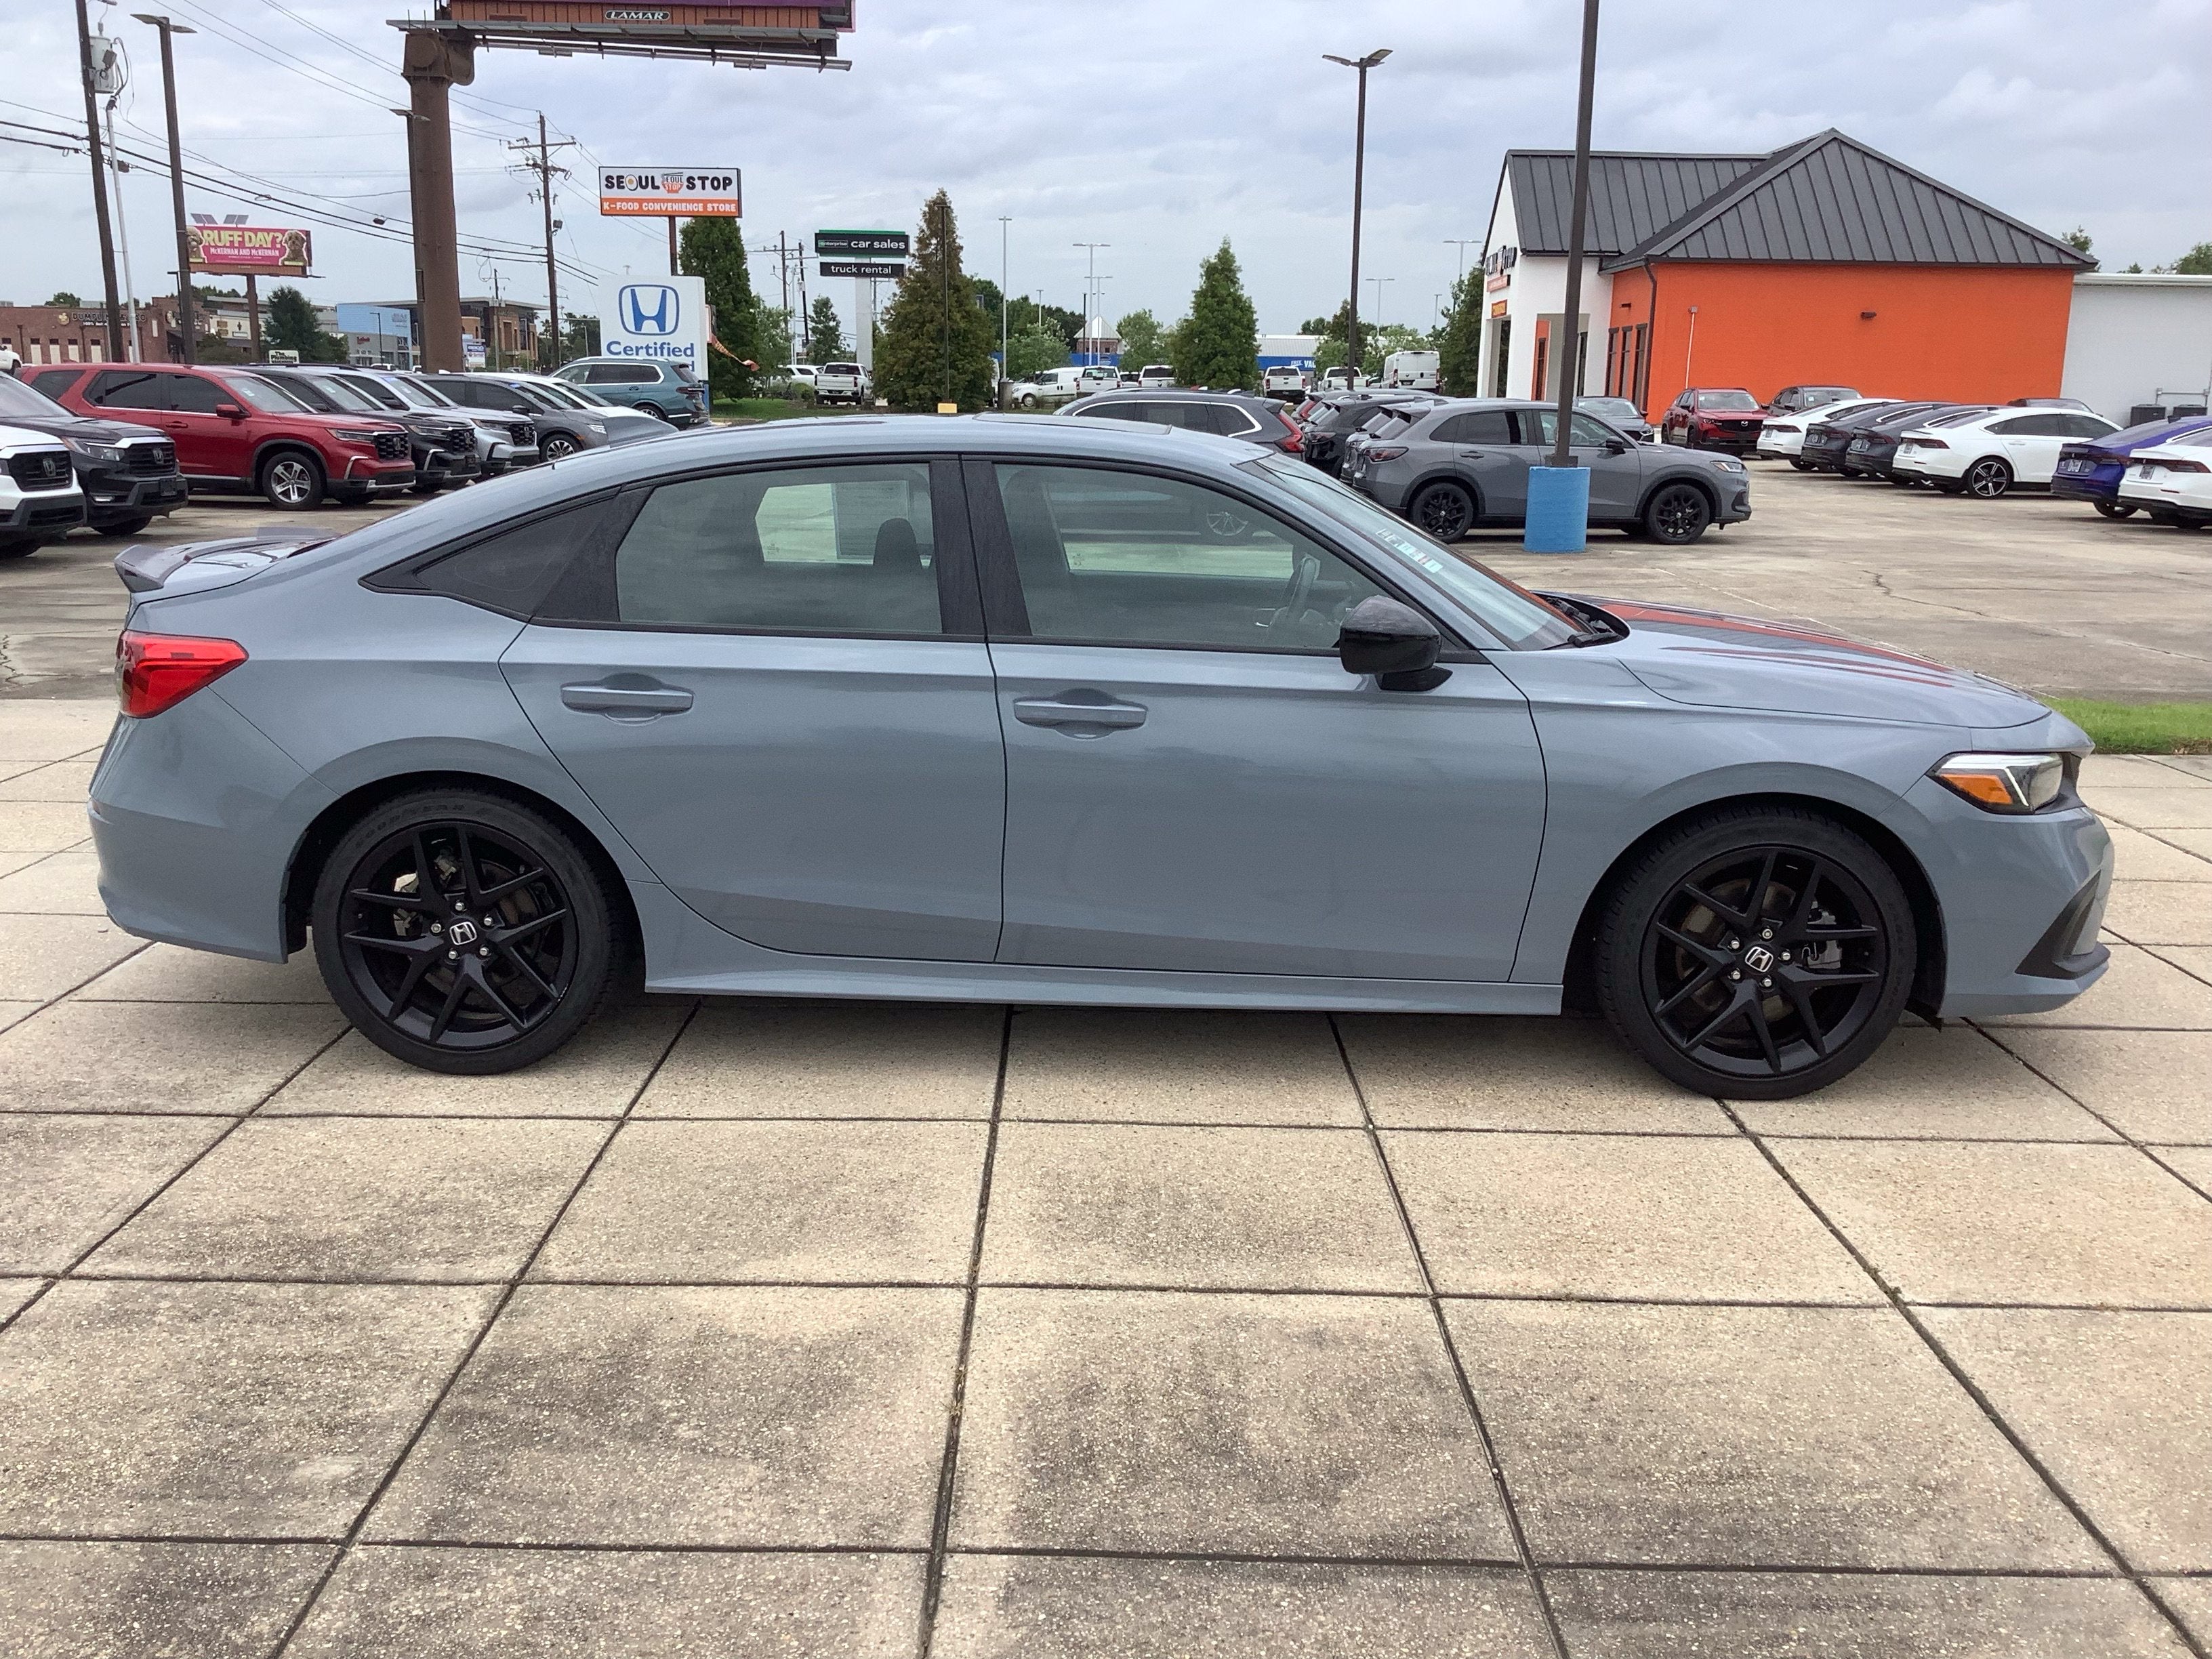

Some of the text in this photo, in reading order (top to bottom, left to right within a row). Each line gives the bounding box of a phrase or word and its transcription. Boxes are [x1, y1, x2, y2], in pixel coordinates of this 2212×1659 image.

[611, 12, 663, 20] LAMAR
[605, 174, 733, 191] SEOUL STOP
[603, 201, 736, 212] K-FOOD CONVENIENCE STORE
[203, 230, 283, 249] RUFF DAY?
[873, 239, 905, 249] sales
[831, 265, 892, 274] truck rental
[607, 340, 695, 357] Certified
